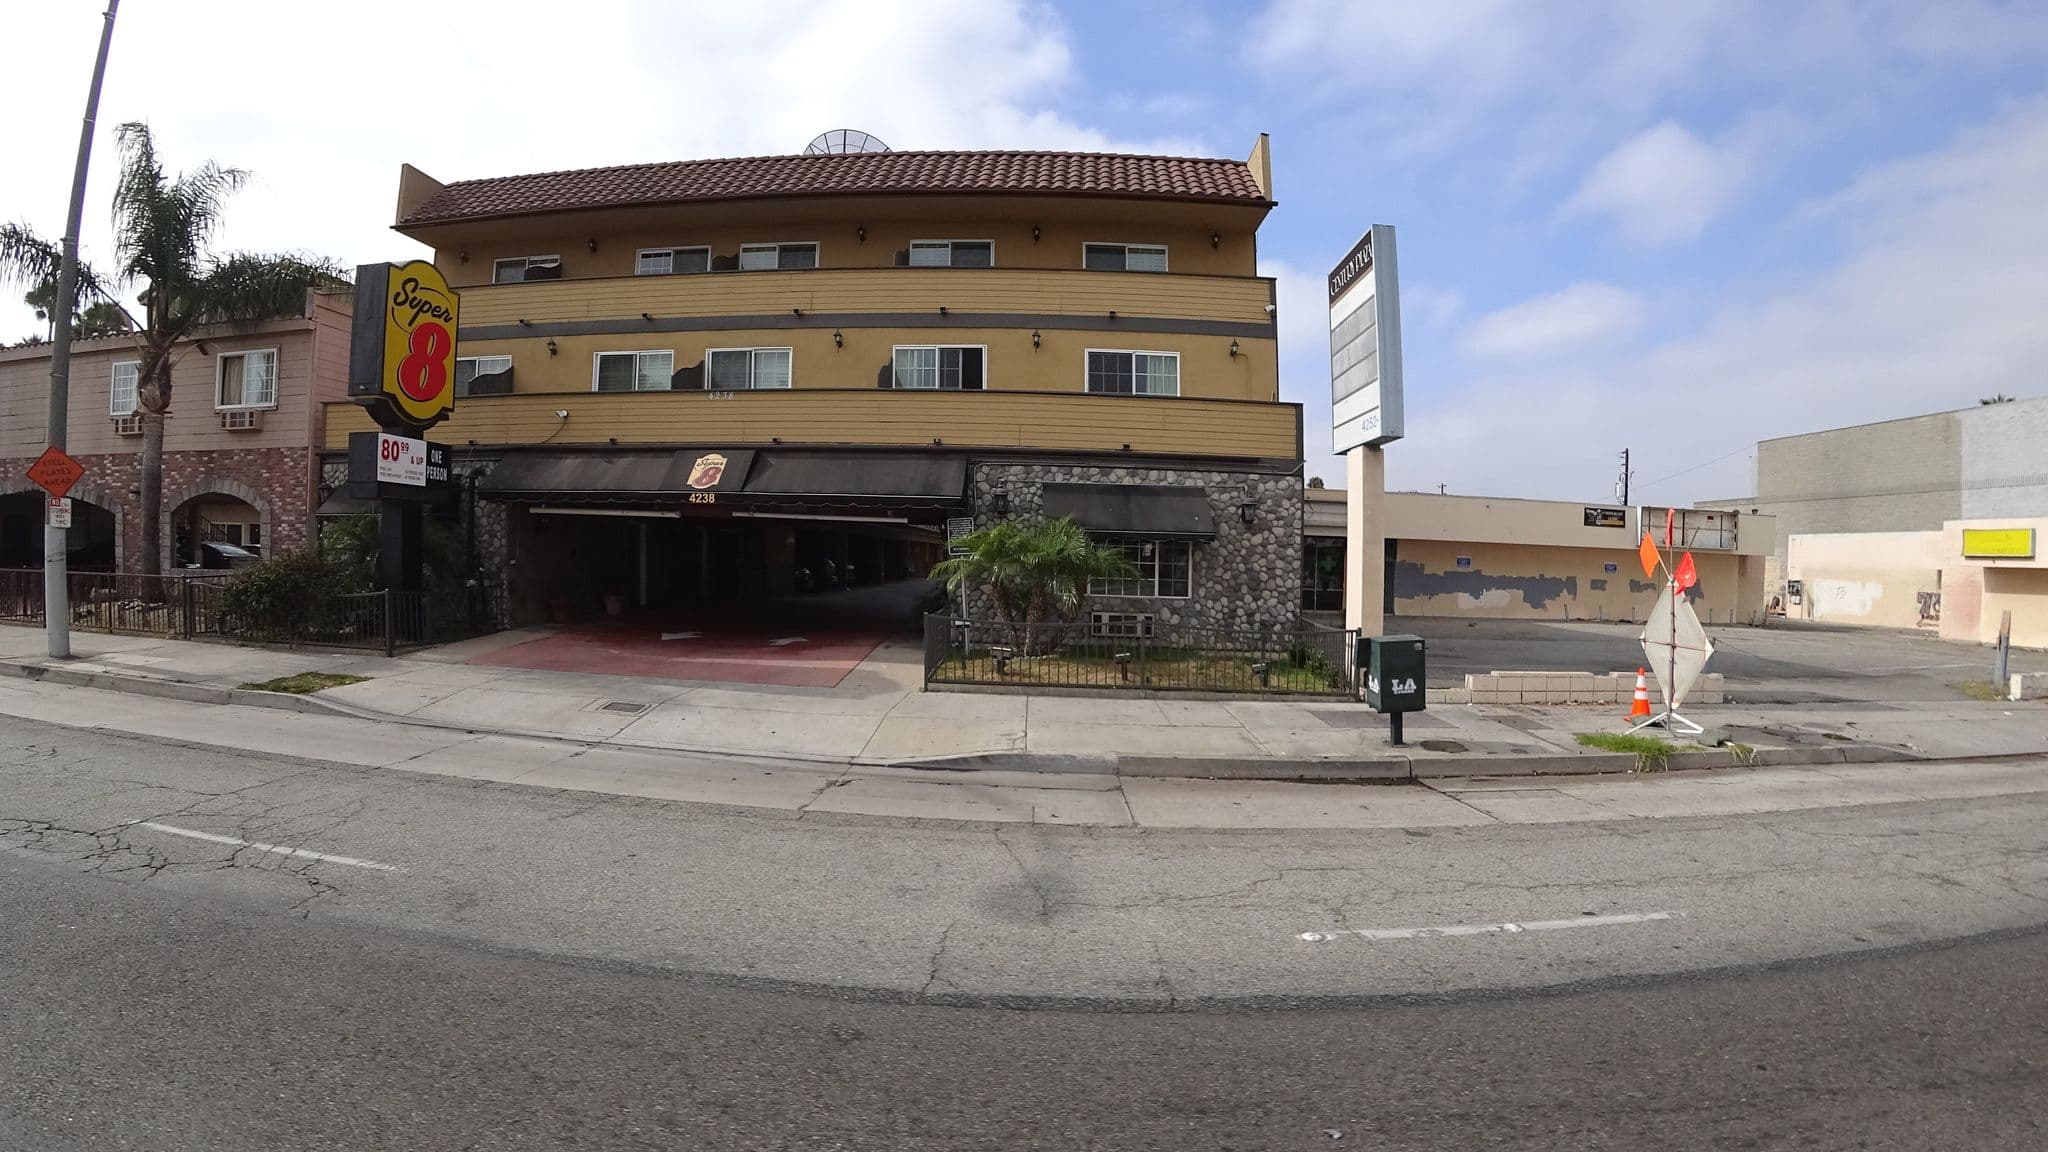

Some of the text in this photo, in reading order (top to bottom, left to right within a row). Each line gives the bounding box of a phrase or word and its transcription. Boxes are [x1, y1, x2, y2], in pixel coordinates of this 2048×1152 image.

[393, 277, 453, 327] Super
[397, 321, 451, 402] 8
[381, 438, 400, 462] 80
[41, 458, 66, 467] STEEL
[416, 456, 424, 465] UP
[431, 449, 442, 464] ONE
[40, 467, 72, 476] PLATES
[427, 465, 448, 481] PERSON
[43, 478, 72, 486] AHEAD
[688, 493, 716, 504] 4238
[1391, 678, 1417, 690] LA
